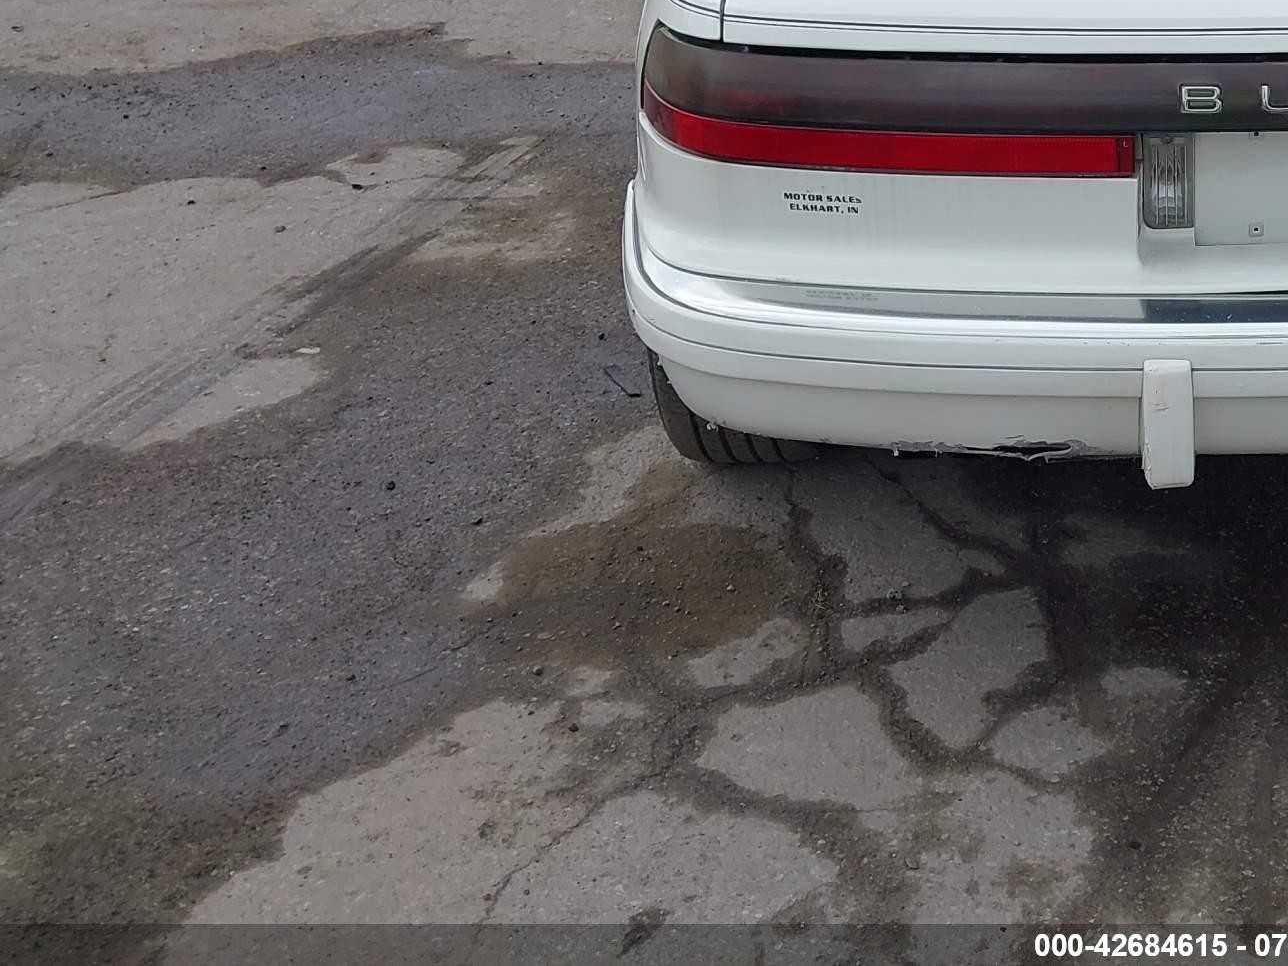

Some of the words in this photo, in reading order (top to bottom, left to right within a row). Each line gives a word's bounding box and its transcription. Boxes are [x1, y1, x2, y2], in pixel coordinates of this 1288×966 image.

[783, 192, 823, 202] MOTOR
[826, 195, 862, 204] SALES
[789, 203, 844, 214] ELKHART,
[847, 206, 859, 214] IN
